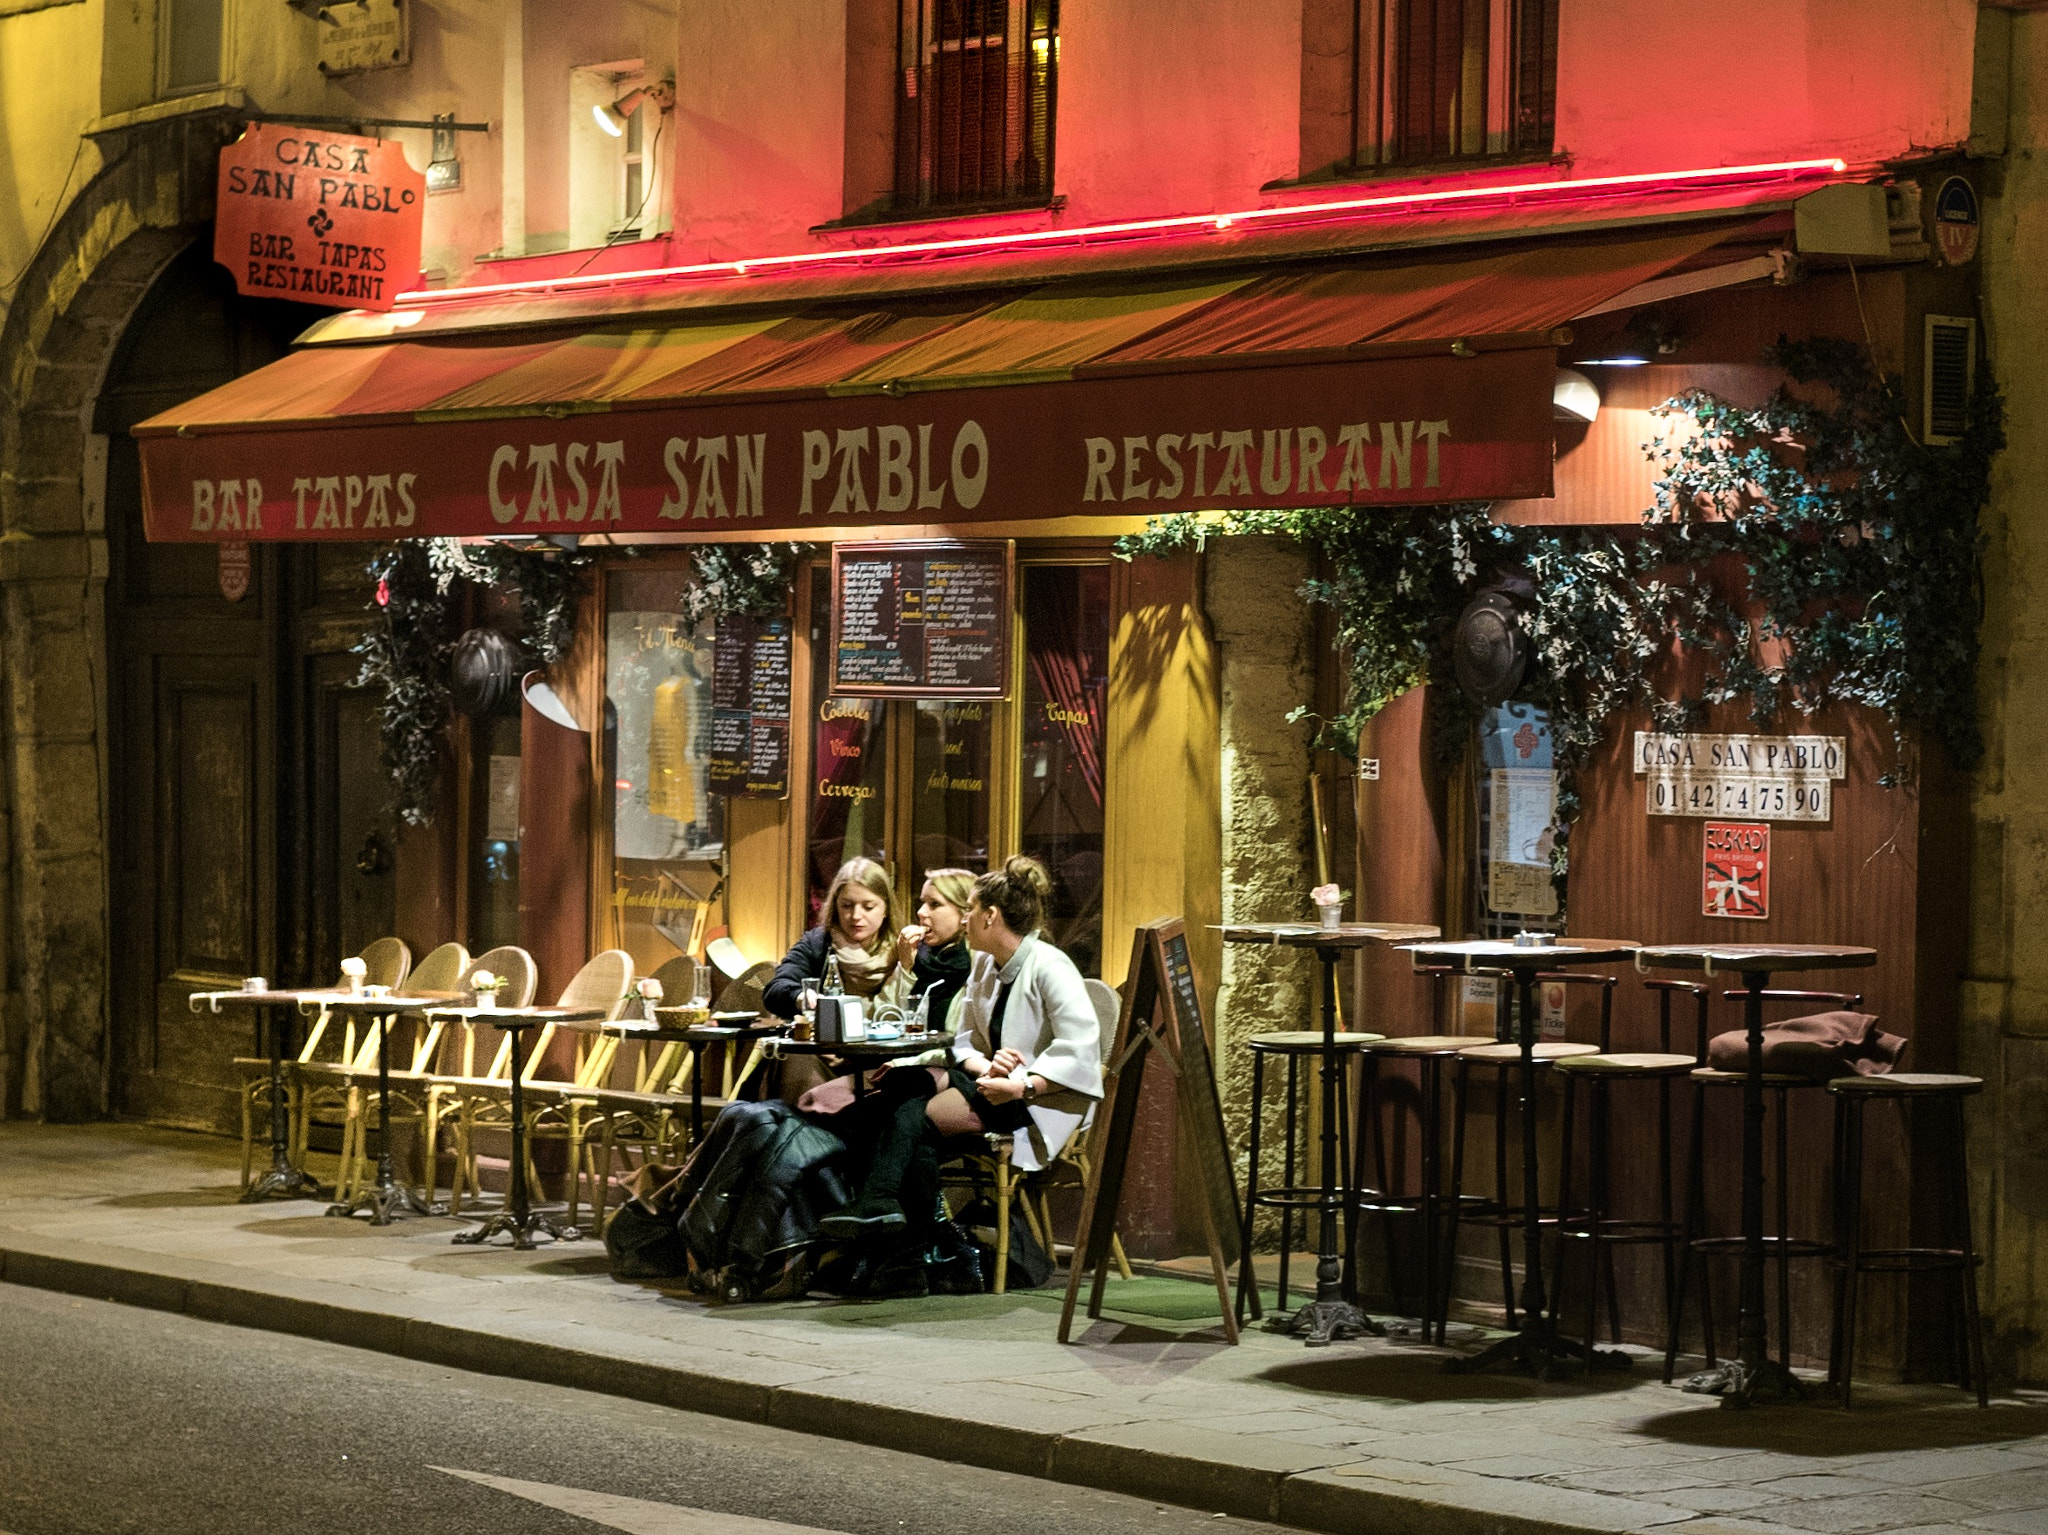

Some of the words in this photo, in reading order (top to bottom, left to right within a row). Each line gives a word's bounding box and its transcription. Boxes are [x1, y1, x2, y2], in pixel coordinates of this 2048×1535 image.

[276, 138, 369, 174] CASA
[229, 166, 295, 200] SAN
[318, 178, 415, 213] PABLO
[250, 232, 295, 261] BAR
[318, 241, 386, 272] TAPAS
[247, 261, 384, 300] RESTAURANT
[190, 478, 264, 532] BAR
[292, 473, 418, 530] TAPAS
[488, 440, 625, 524] CASA
[656, 433, 767, 520] SAN
[798, 420, 989, 516] PABLO
[1082, 419, 1452, 502] RESTAURANT
[1045, 702, 1089, 730] Tapas
[1643, 741, 1696, 766] CASA
[1710, 743, 1751, 768] SAN
[1766, 744, 1838, 770] PABLO
[1656, 783, 1678, 807] 01
[1690, 784, 1714, 808] 42
[1725, 786, 1748, 810] 74
[1759, 787, 1784, 811] 75
[1794, 787, 1820, 812] 90
[1707, 828, 1768, 853] EUSKADI
